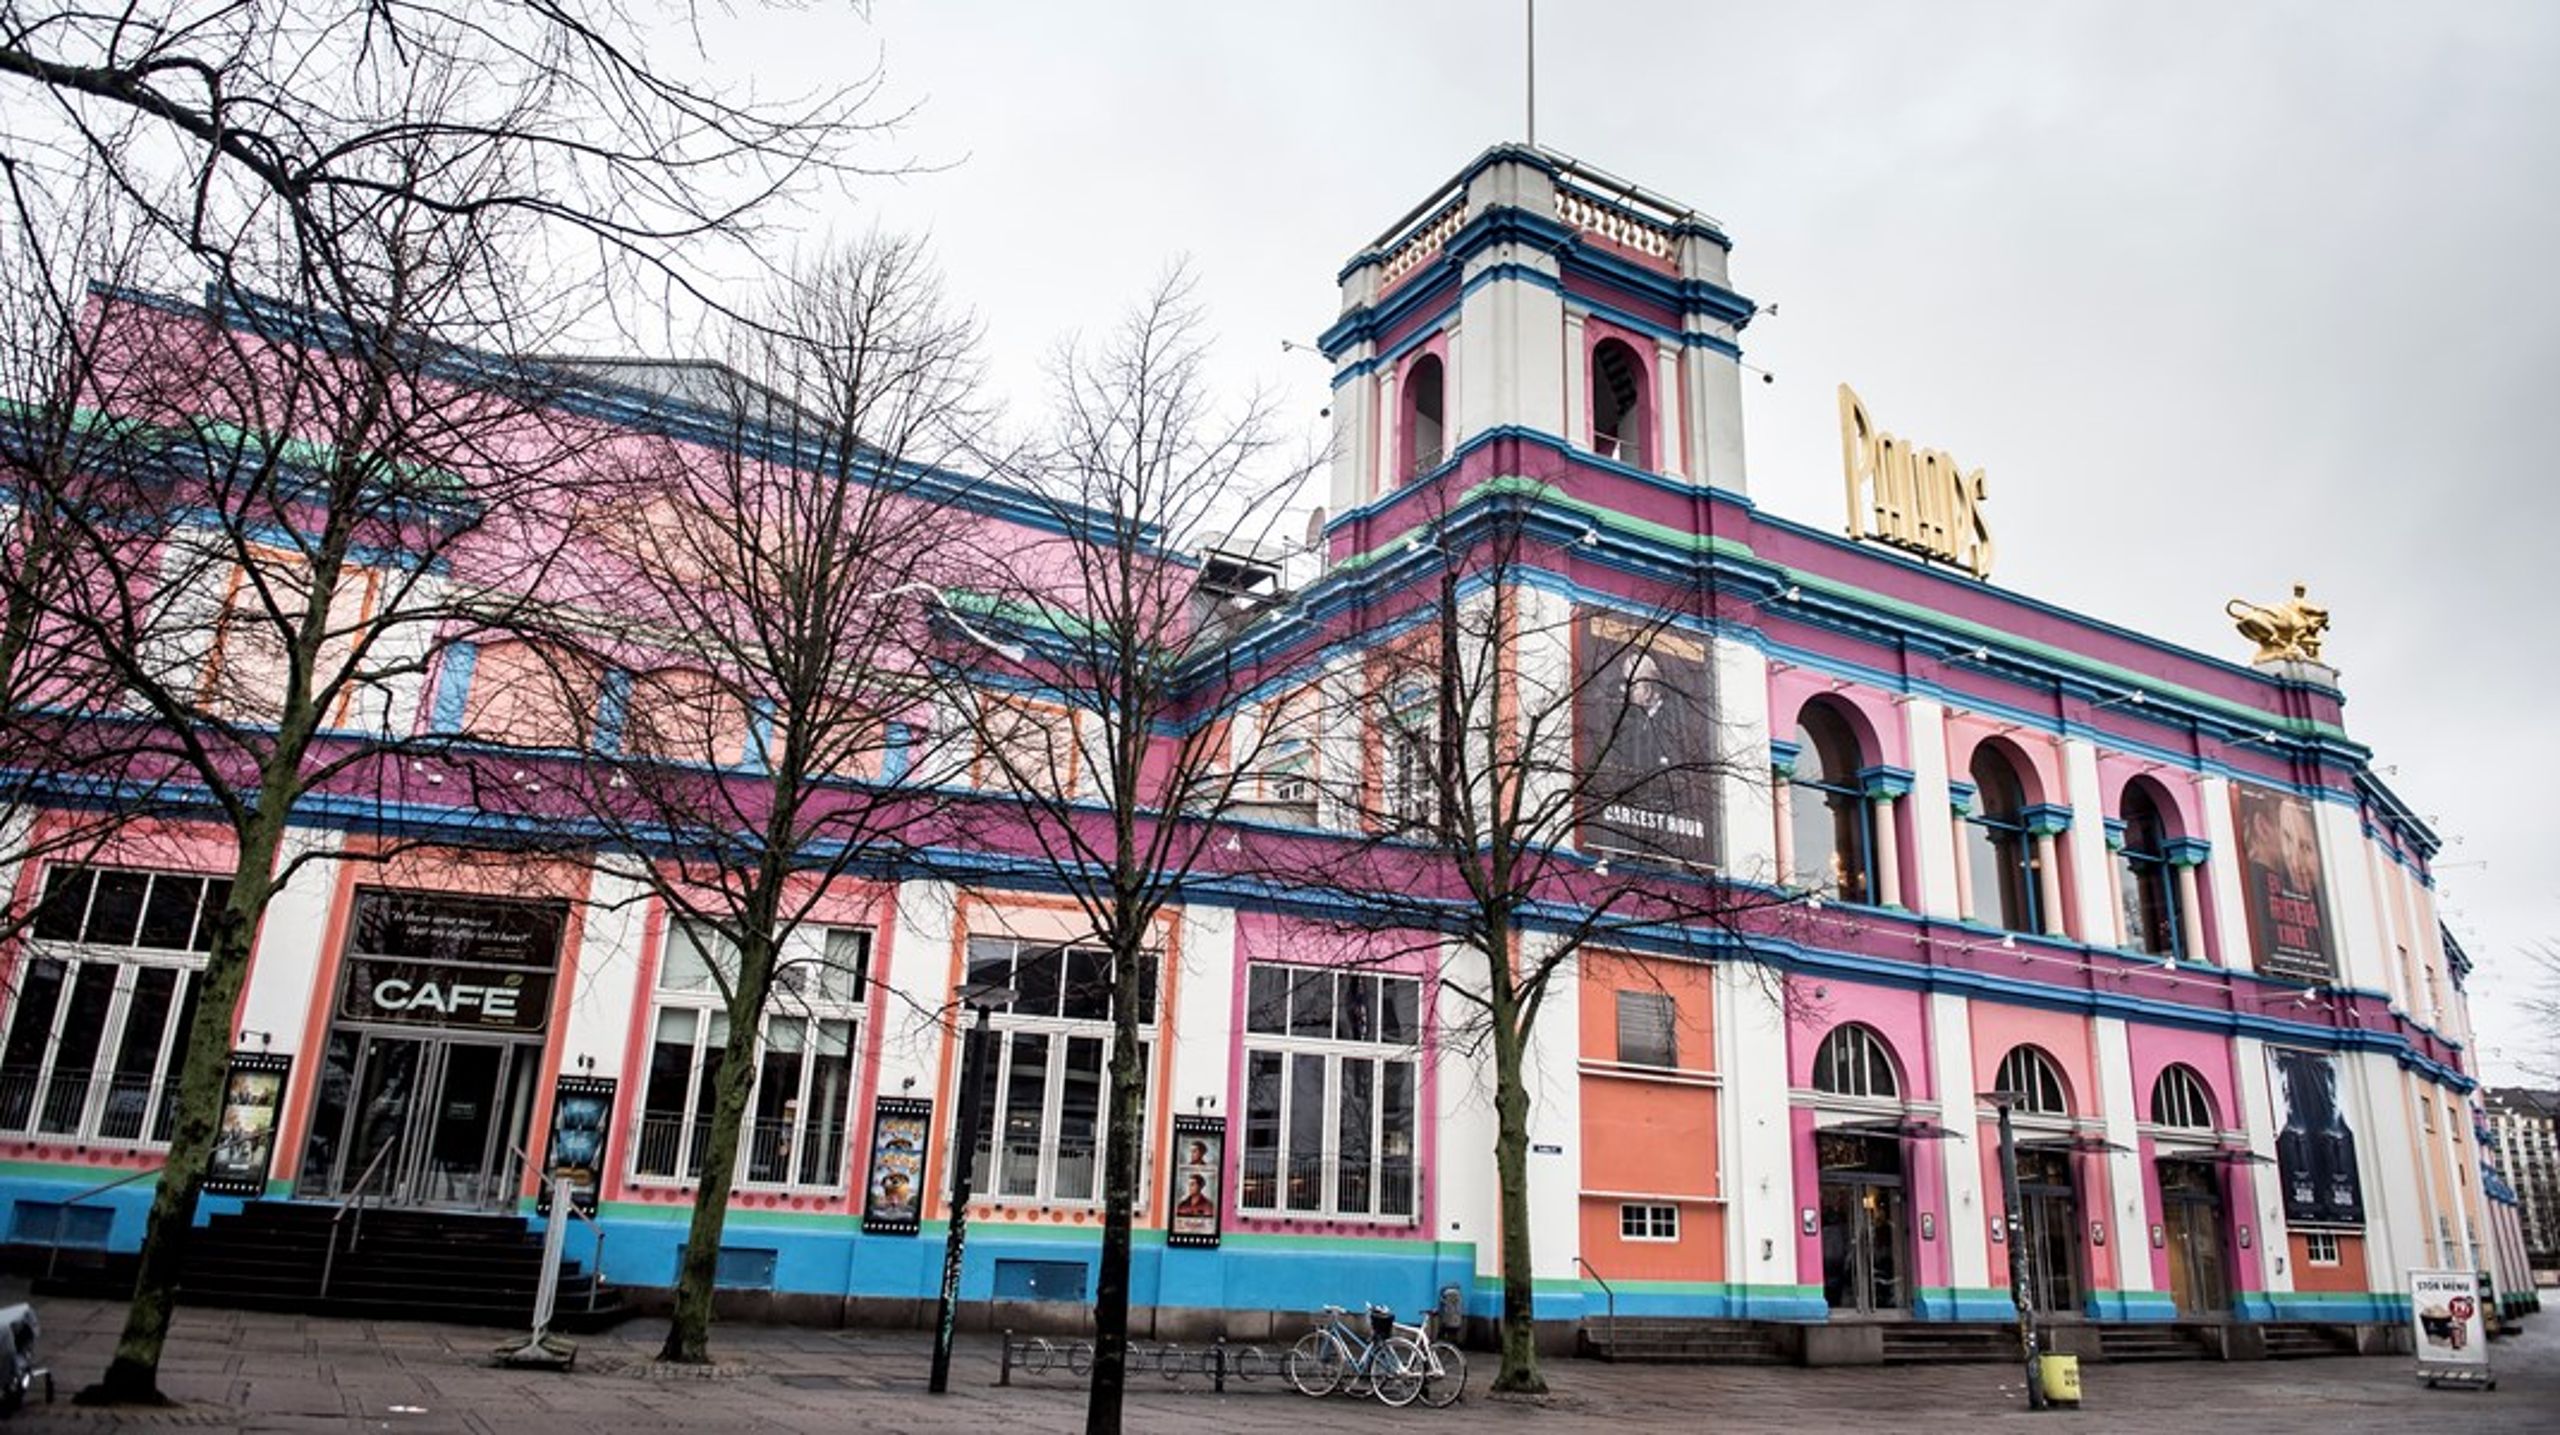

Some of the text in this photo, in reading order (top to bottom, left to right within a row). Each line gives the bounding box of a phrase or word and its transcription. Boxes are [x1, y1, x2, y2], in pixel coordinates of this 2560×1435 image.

[1667, 814, 1704, 838] HOUR
[374, 974, 522, 1016] CAFÉ
[2417, 1281, 2470, 1291] STOR MENU
